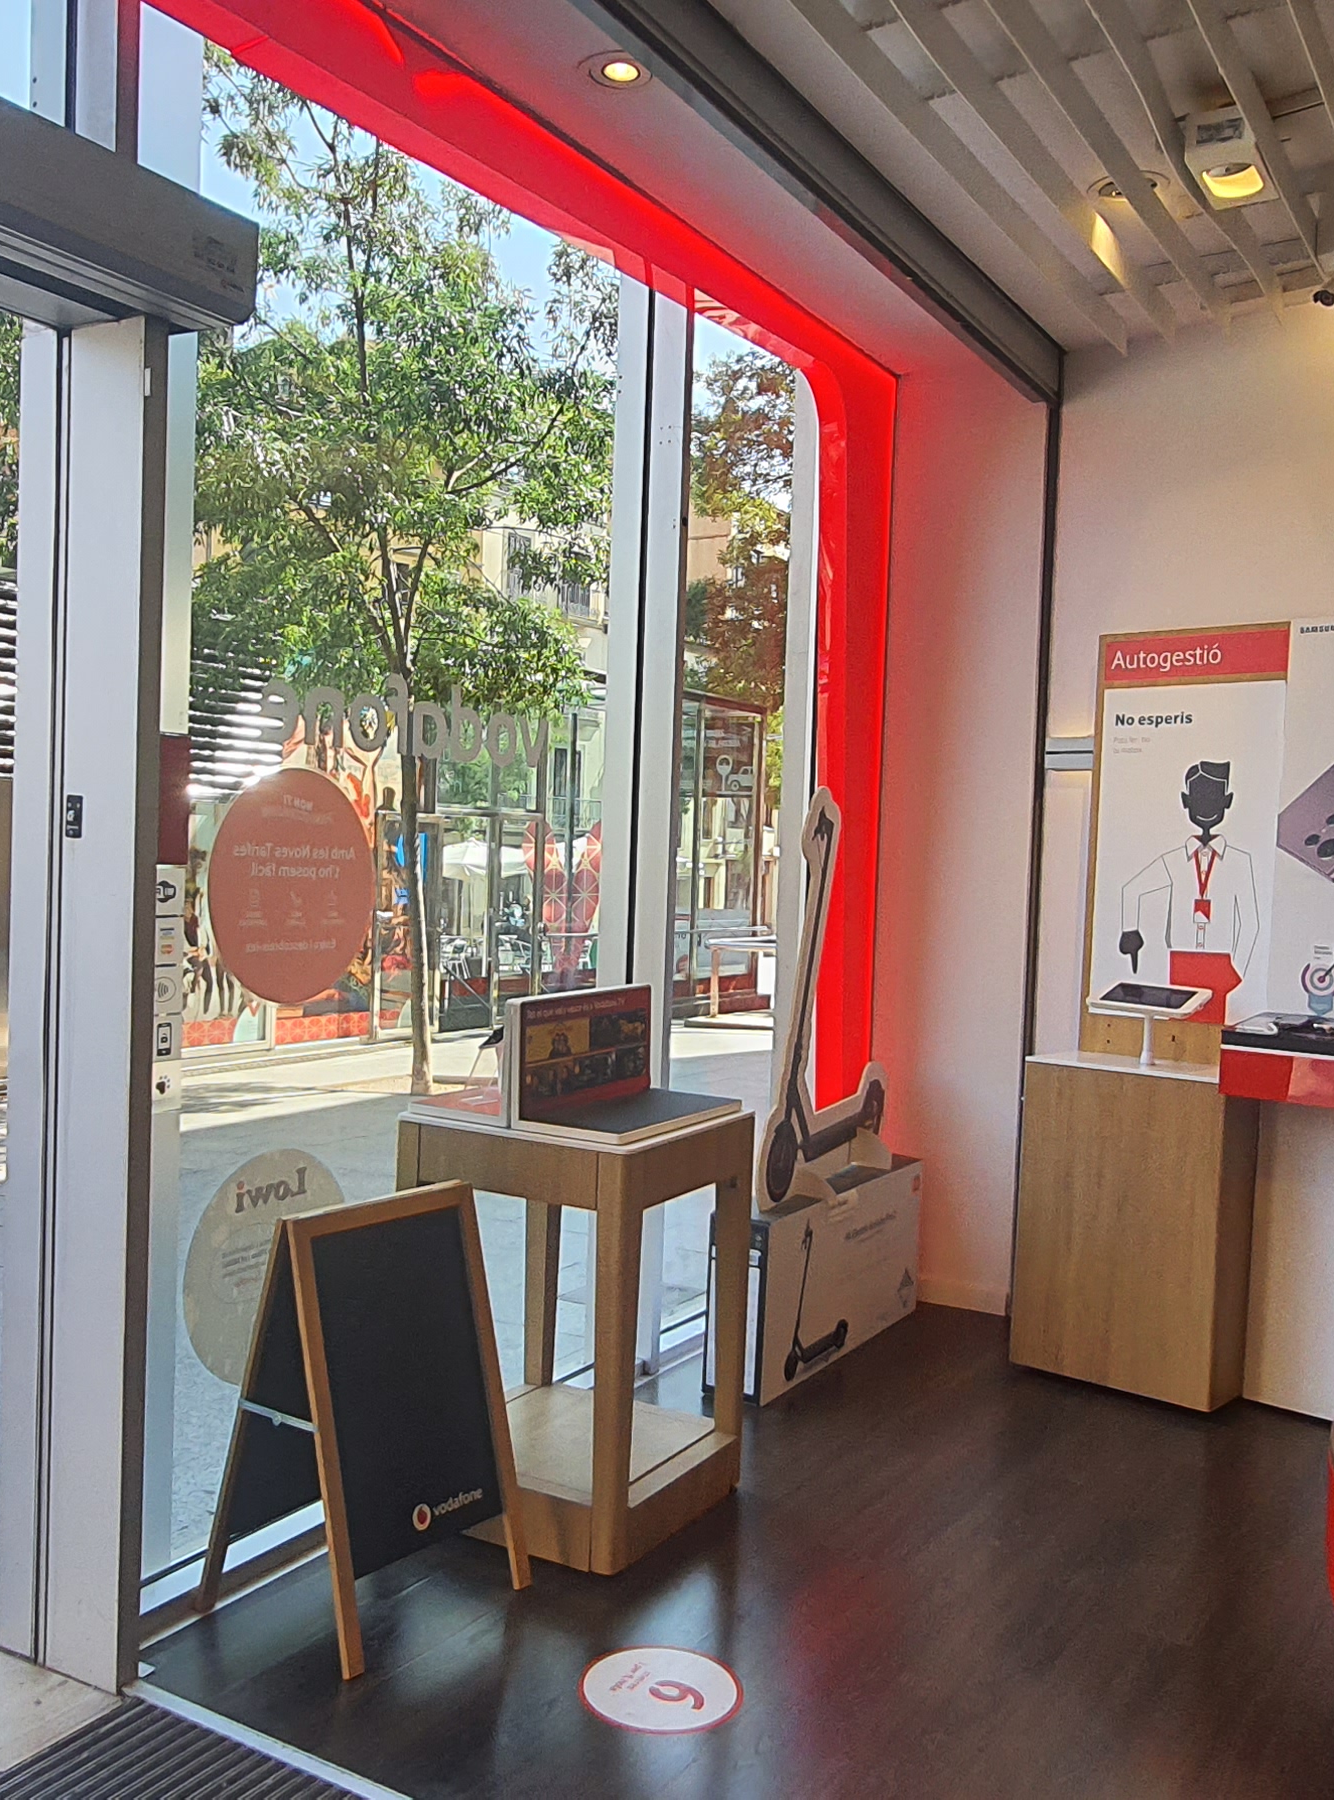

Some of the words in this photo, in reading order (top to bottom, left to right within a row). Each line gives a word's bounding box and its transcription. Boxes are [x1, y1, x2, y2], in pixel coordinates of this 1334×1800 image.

[1111, 643, 1222, 672] Autogestió
[1115, 713, 1135, 726] No
[1138, 711, 1193, 728] esperis
[433, 1488, 483, 1516] vodafone
